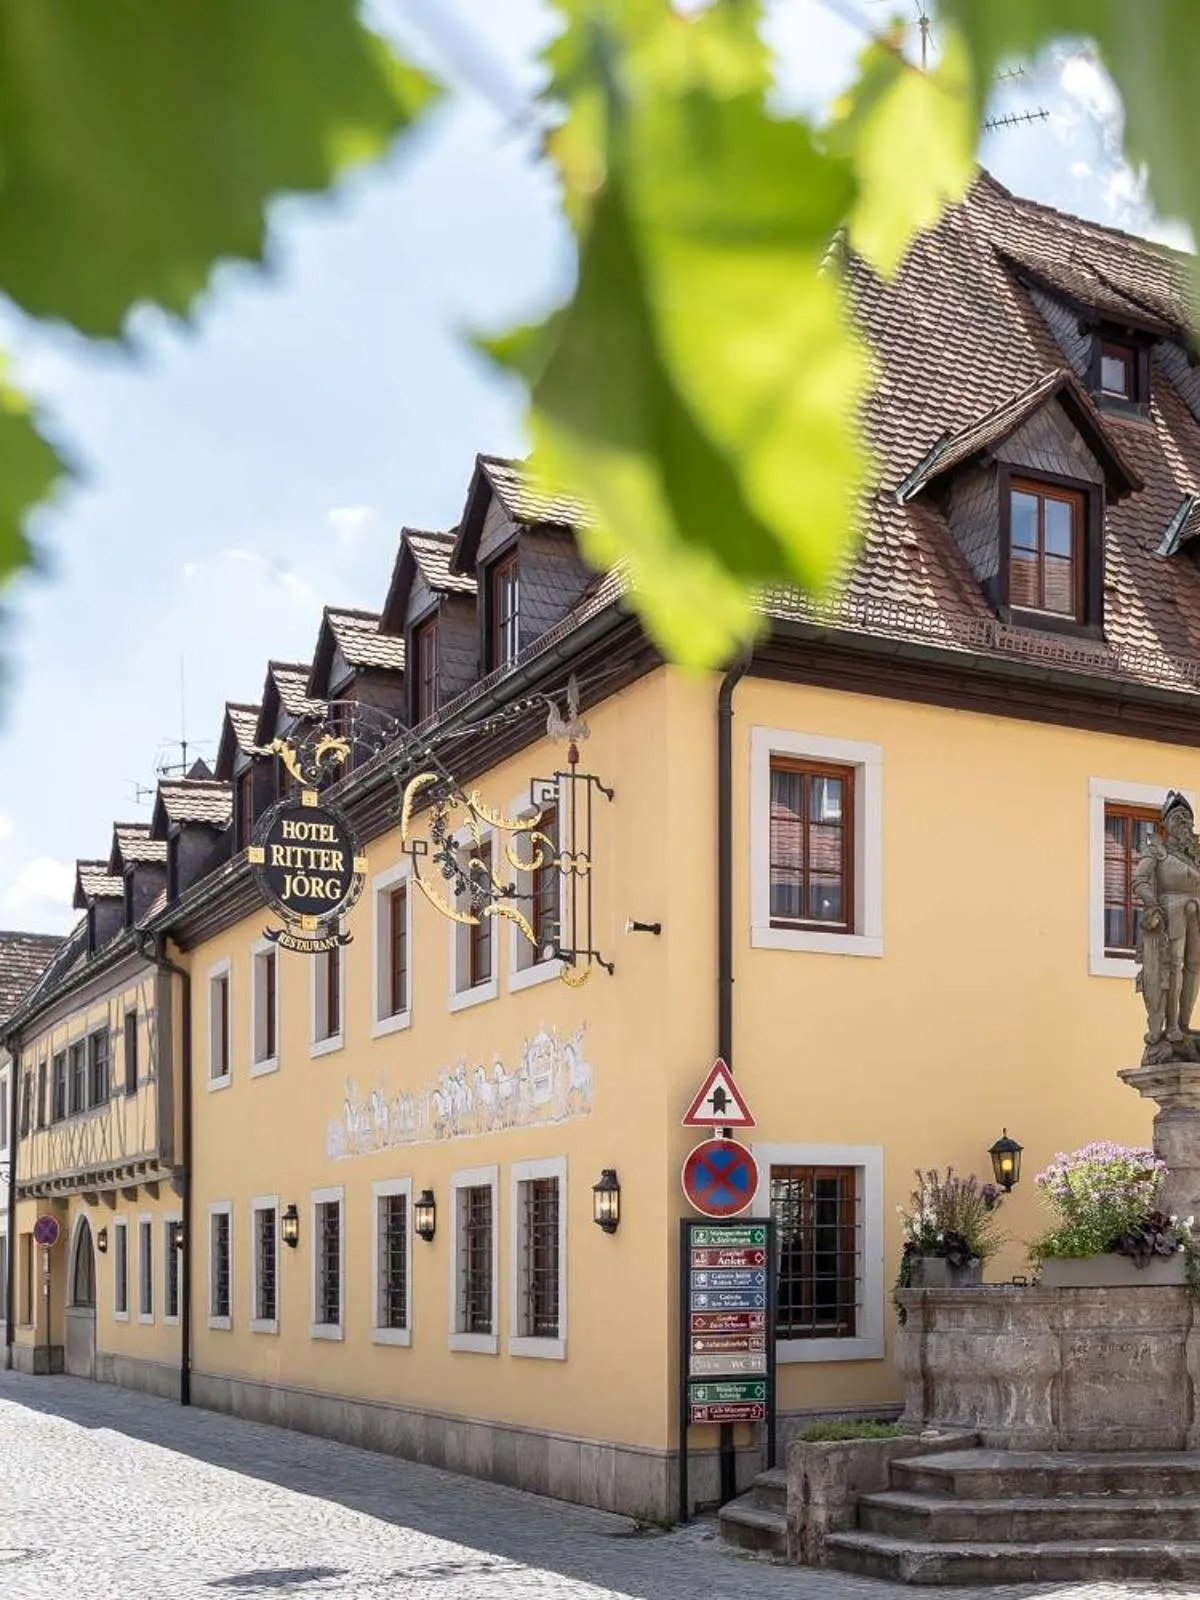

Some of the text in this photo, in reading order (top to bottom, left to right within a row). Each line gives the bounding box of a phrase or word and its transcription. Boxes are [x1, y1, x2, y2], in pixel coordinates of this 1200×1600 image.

[281, 820, 339, 843] HOTEL
[270, 844, 345, 872] RITTER
[281, 870, 342, 900] JÖRG
[279, 931, 339, 952] RESTAURANT
[718, 1256, 747, 1265] Anker
[730, 1359, 747, 1369] WC
